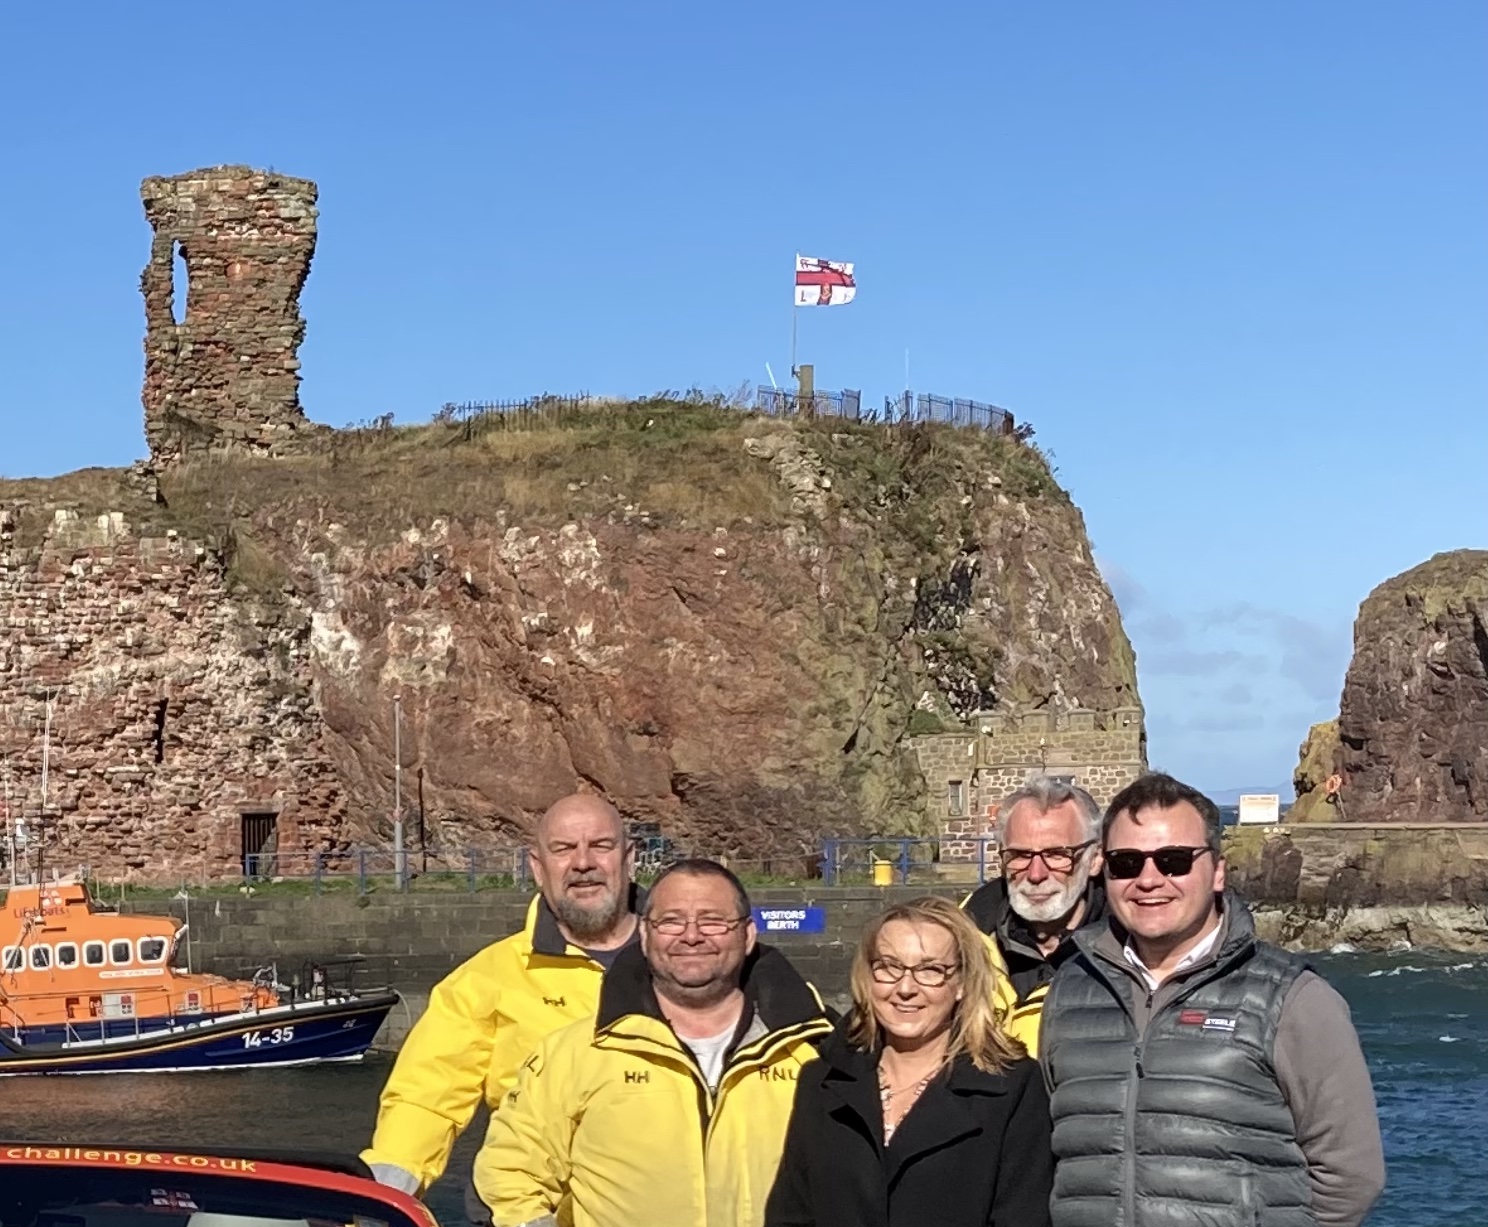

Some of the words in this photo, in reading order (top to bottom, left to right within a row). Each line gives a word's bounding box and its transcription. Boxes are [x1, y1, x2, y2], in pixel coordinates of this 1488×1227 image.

[761, 910, 806, 920] VISITORS
[766, 920, 799, 930] BERTH
[242, 1026, 294, 1048] 14-35
[624, 1070, 650, 1083] HH
[759, 1065, 797, 1082] RNL
